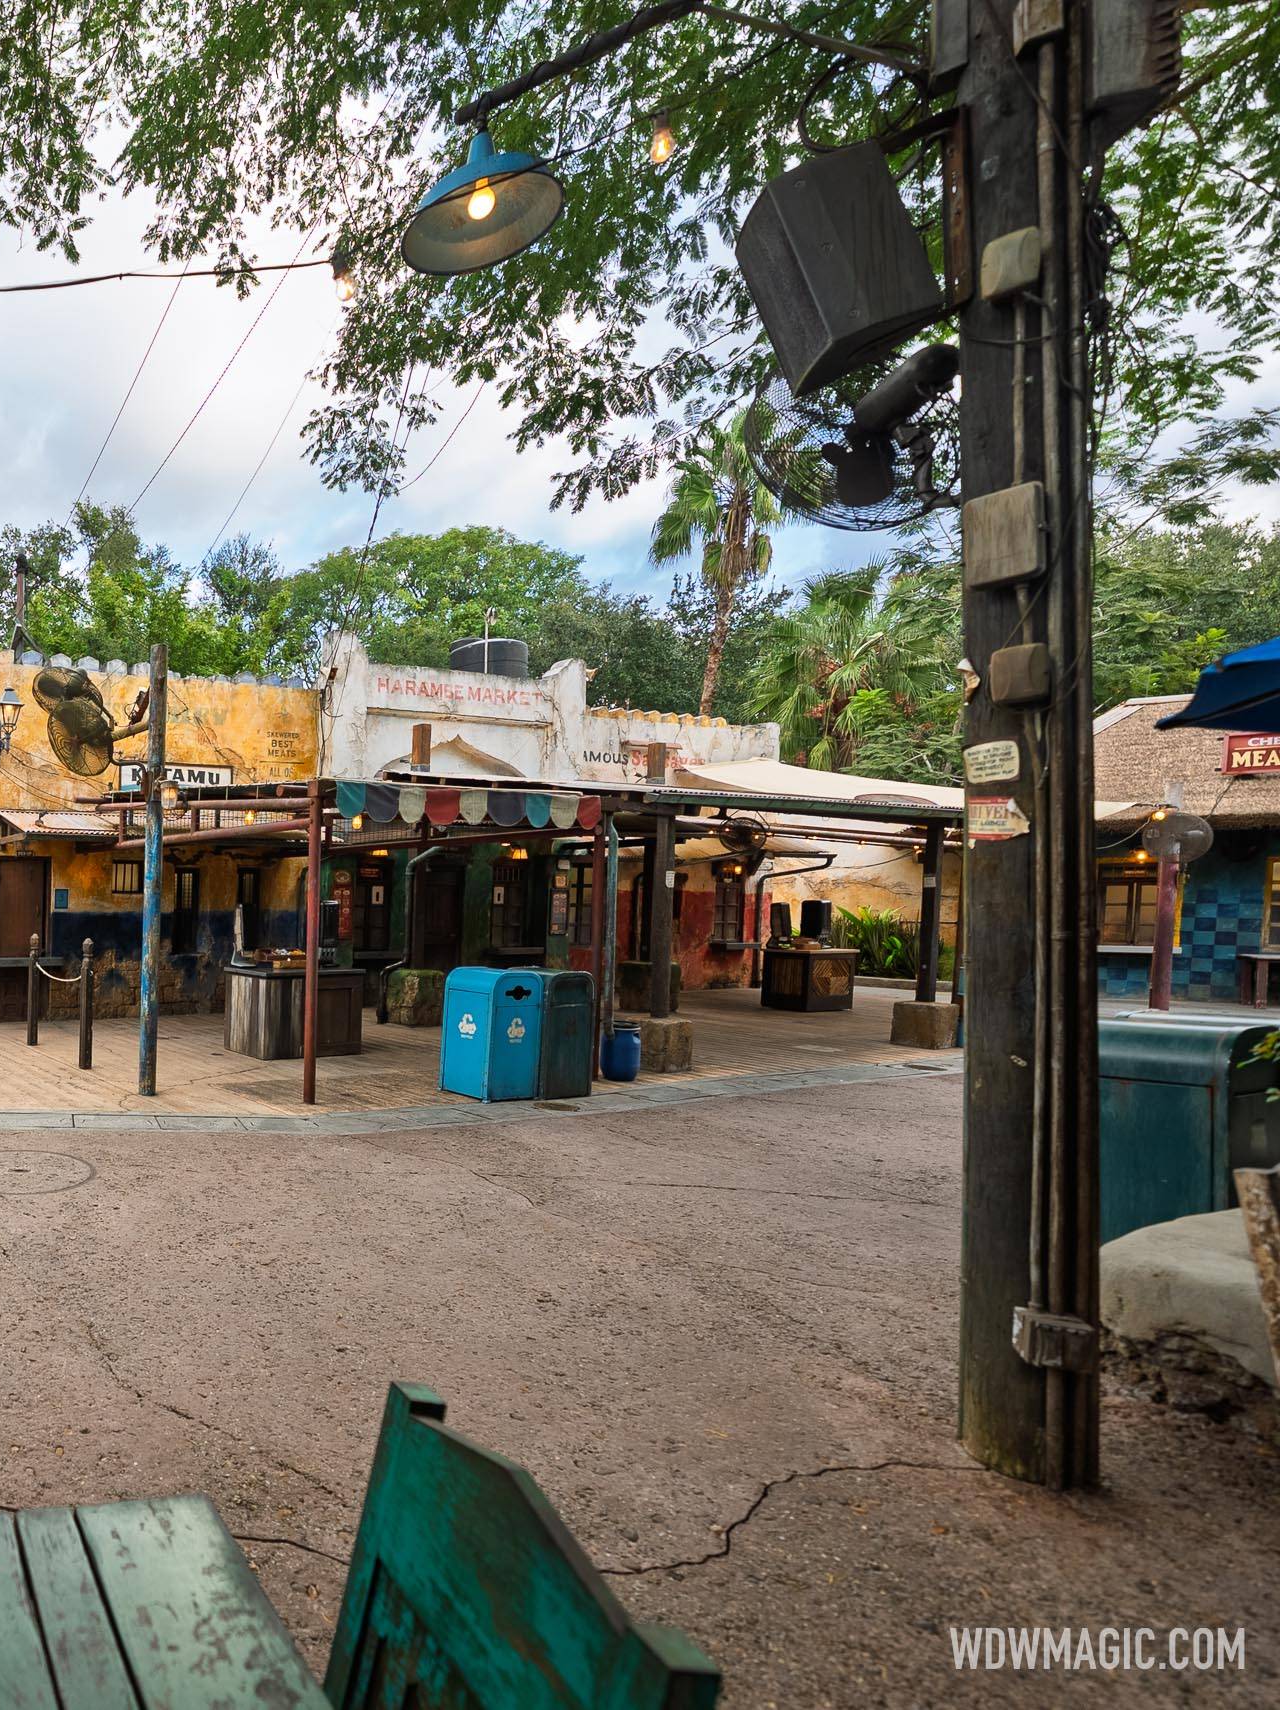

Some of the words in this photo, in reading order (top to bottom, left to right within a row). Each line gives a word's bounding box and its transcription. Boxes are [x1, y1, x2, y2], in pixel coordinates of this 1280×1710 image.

[377, 677, 464, 702] HARAMBE
[467, 686, 544, 706] MARKET
[271, 739, 295, 748] BEST
[267, 749, 297, 758] MEATS
[131, 767, 220, 785] KTAMU
[269, 767, 280, 778] ALL
